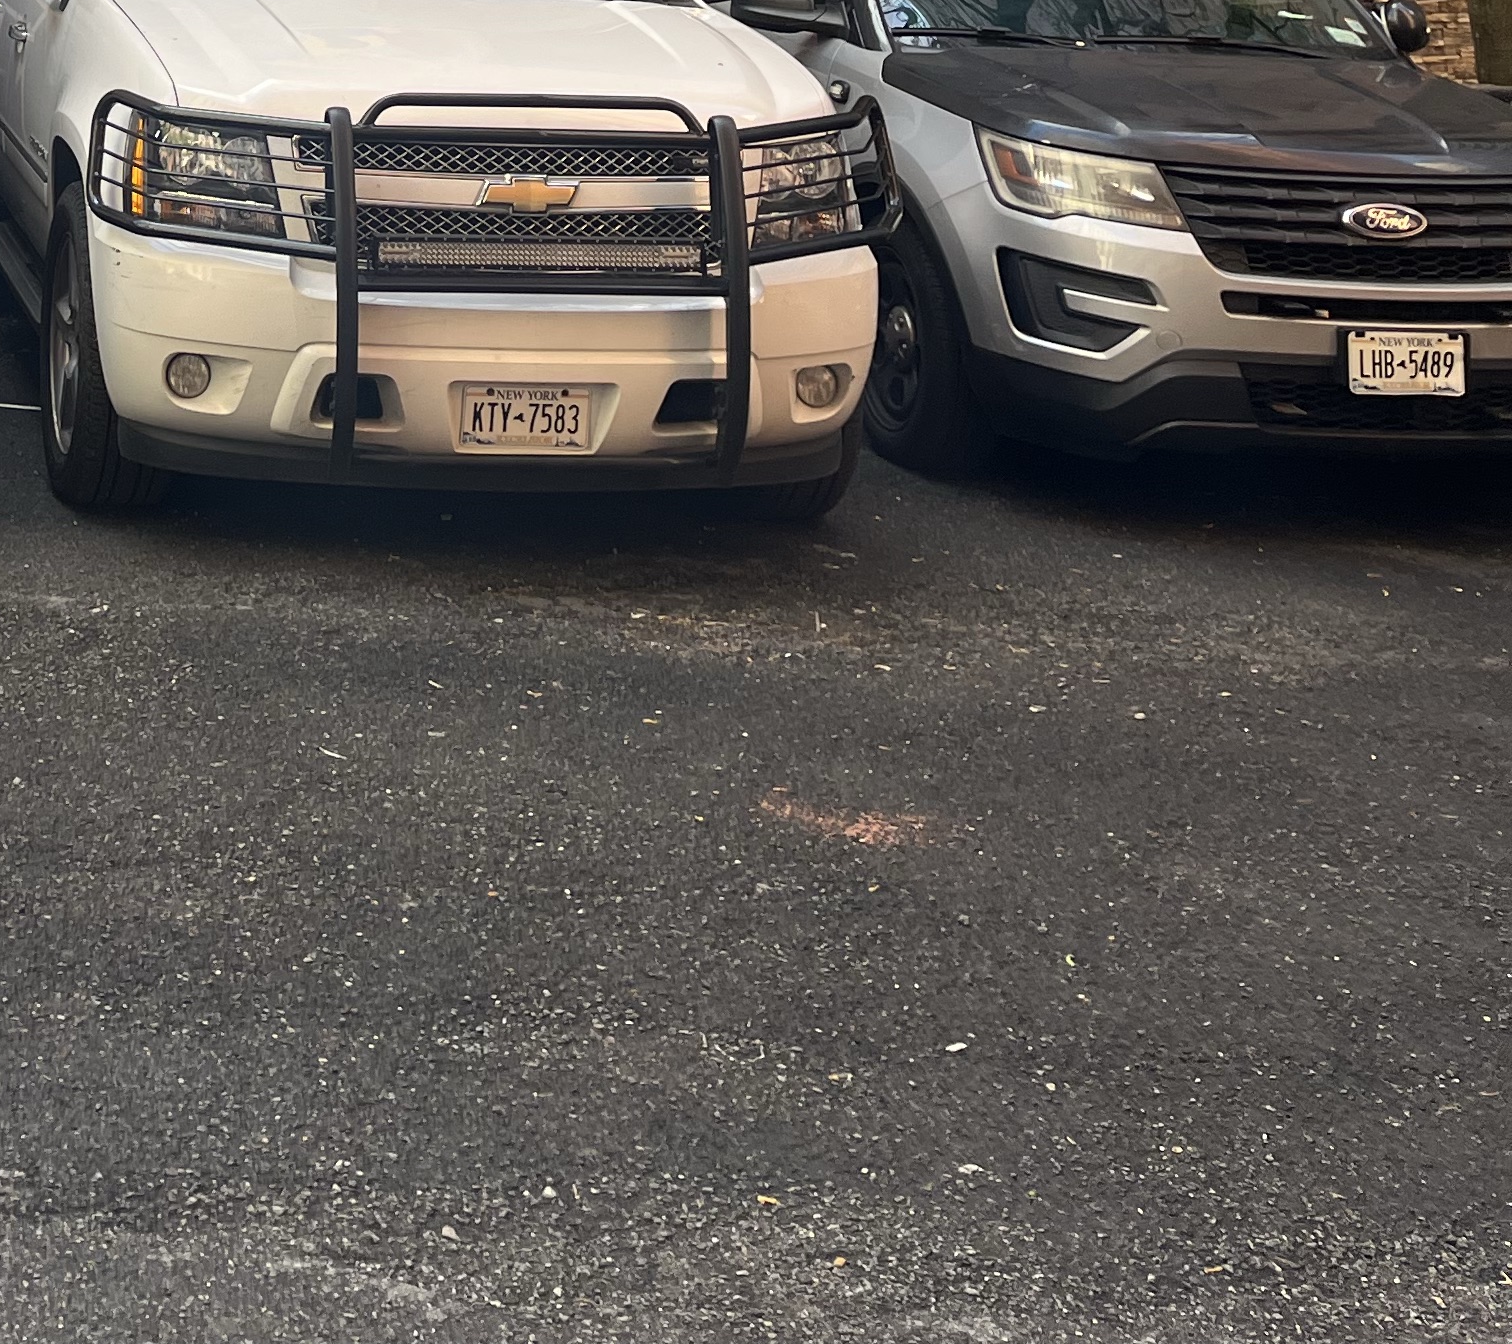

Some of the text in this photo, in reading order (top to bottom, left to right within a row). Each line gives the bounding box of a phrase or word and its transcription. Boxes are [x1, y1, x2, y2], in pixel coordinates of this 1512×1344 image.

[1365, 207, 1411, 230] Ford
[1378, 337, 1434, 347] NEW YORK
[496, 389, 559, 401] NEW YORK
